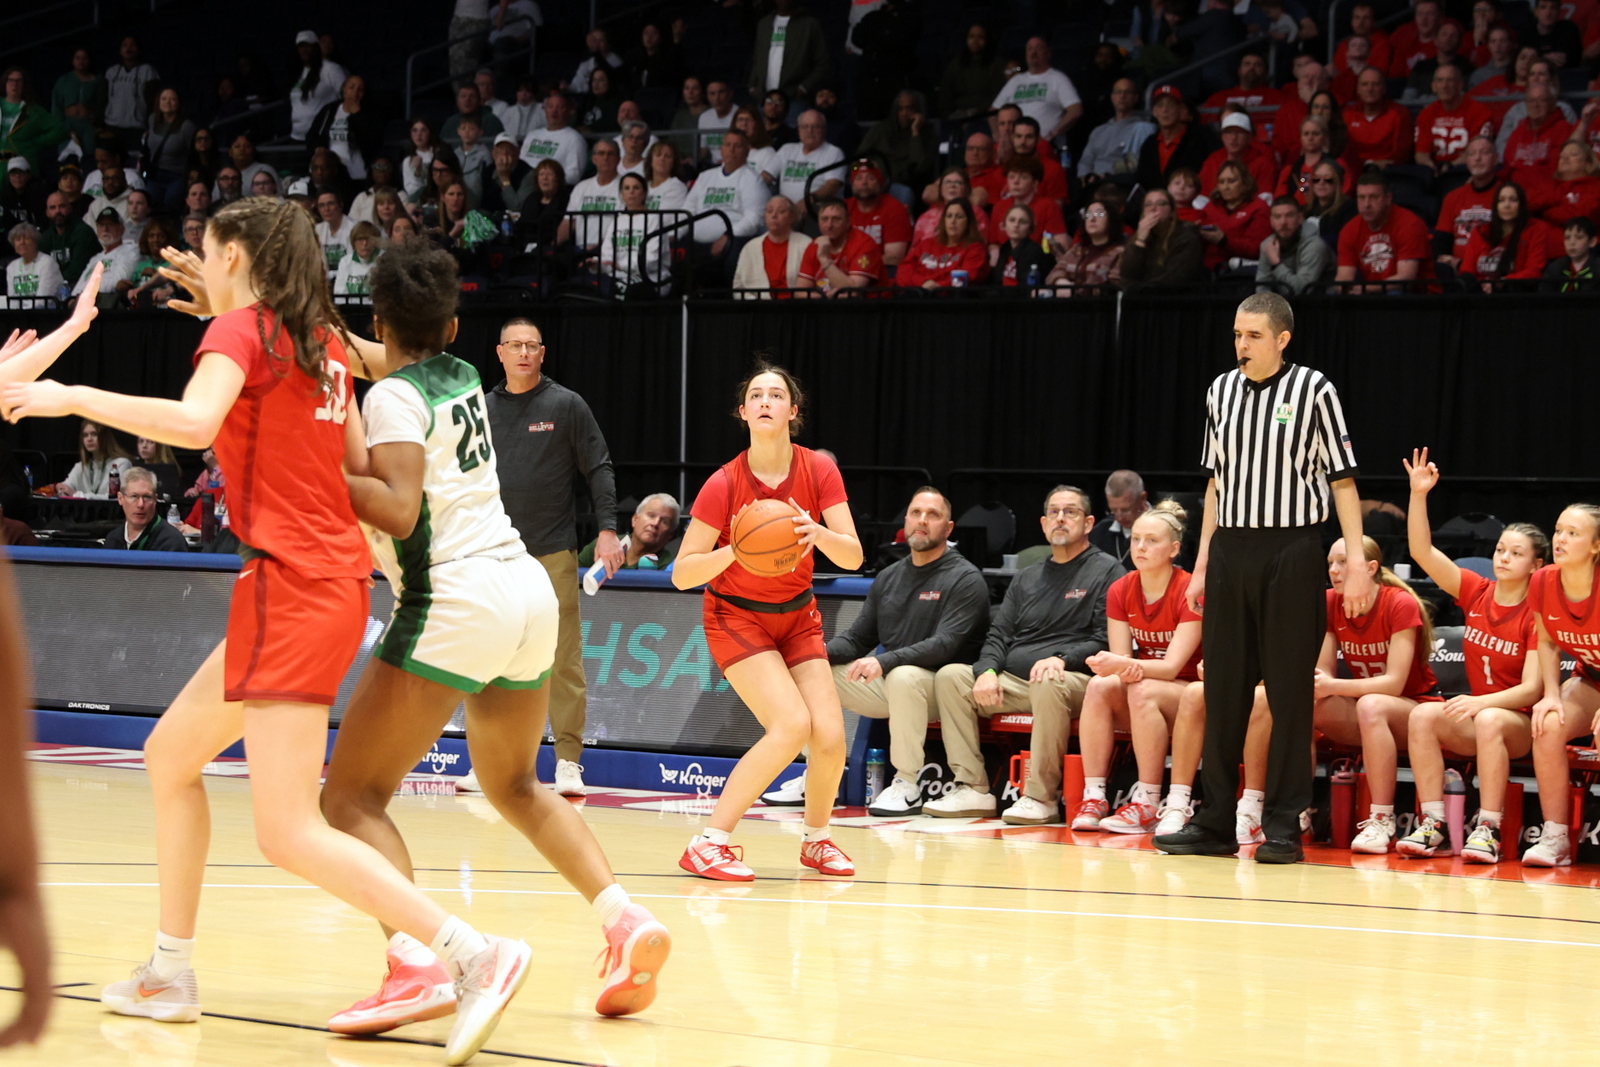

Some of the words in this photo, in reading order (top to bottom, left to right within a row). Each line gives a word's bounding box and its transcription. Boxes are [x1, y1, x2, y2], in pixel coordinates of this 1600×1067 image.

[452, 394, 491, 473] 25
[1463, 625, 1520, 656] BELLEVUE
[1481, 655, 1494, 685] 1
[68, 701, 111, 711] DAKTRONICS
[679, 763, 727, 795] Kroger
